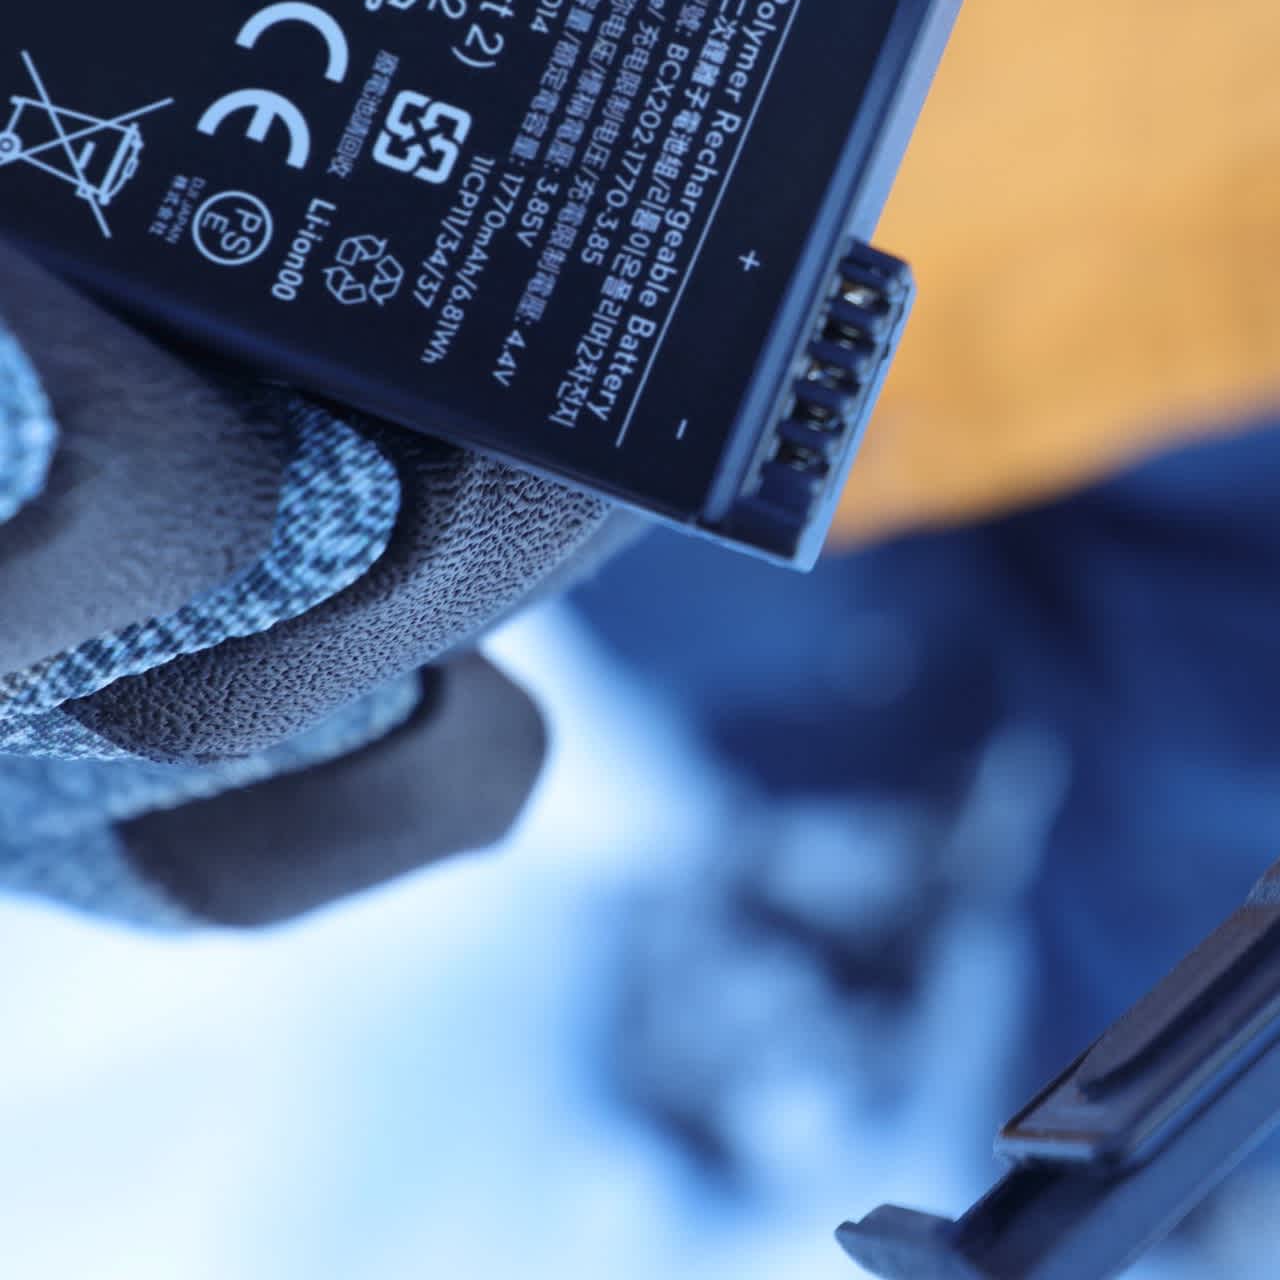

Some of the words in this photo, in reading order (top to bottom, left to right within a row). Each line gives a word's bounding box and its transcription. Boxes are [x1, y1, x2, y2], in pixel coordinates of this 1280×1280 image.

[197, 2, 348, 169] CE
[452, 17, 504, 68] 2)
[581, 43, 689, 265] BCX202-1770-3.85
[639, 101, 742, 311] Rechargeable
[272, 198, 336, 300] Li-ion00
[517, 177, 559, 248] 3.85V
[421, 173, 524, 363] 1770mAh/6.81Wh
[493, 330, 525, 386] 4.4V
[587, 313, 653, 420] Battery
